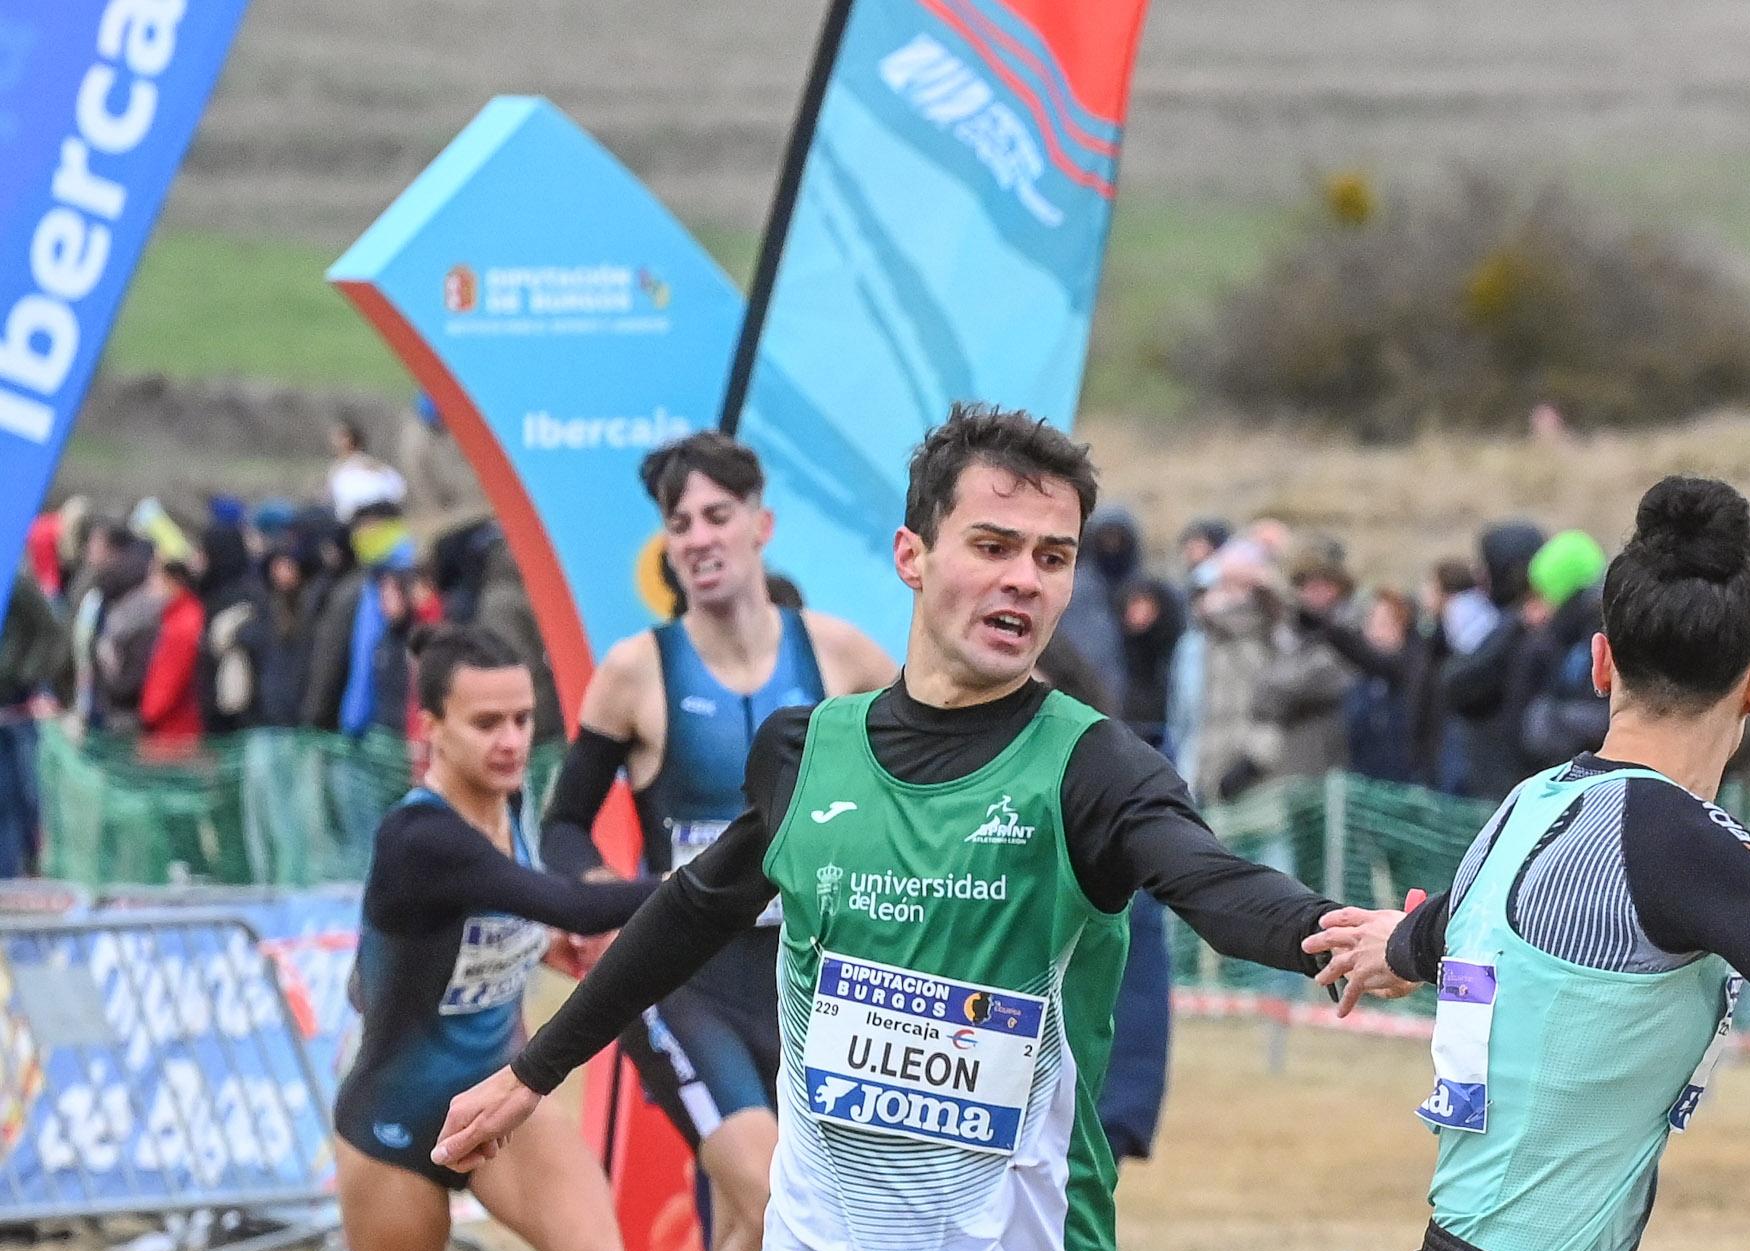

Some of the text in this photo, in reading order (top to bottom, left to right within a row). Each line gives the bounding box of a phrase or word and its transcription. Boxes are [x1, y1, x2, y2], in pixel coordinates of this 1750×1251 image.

[850, 869, 1007, 901] universidad
[840, 963, 950, 1001] DIPUTACIÓN
[815, 1000, 839, 1017] 229
[866, 1011, 940, 1040] Ibercaja
[847, 1034, 980, 1093] U.LEON
[1024, 1044, 1034, 1058] 2
